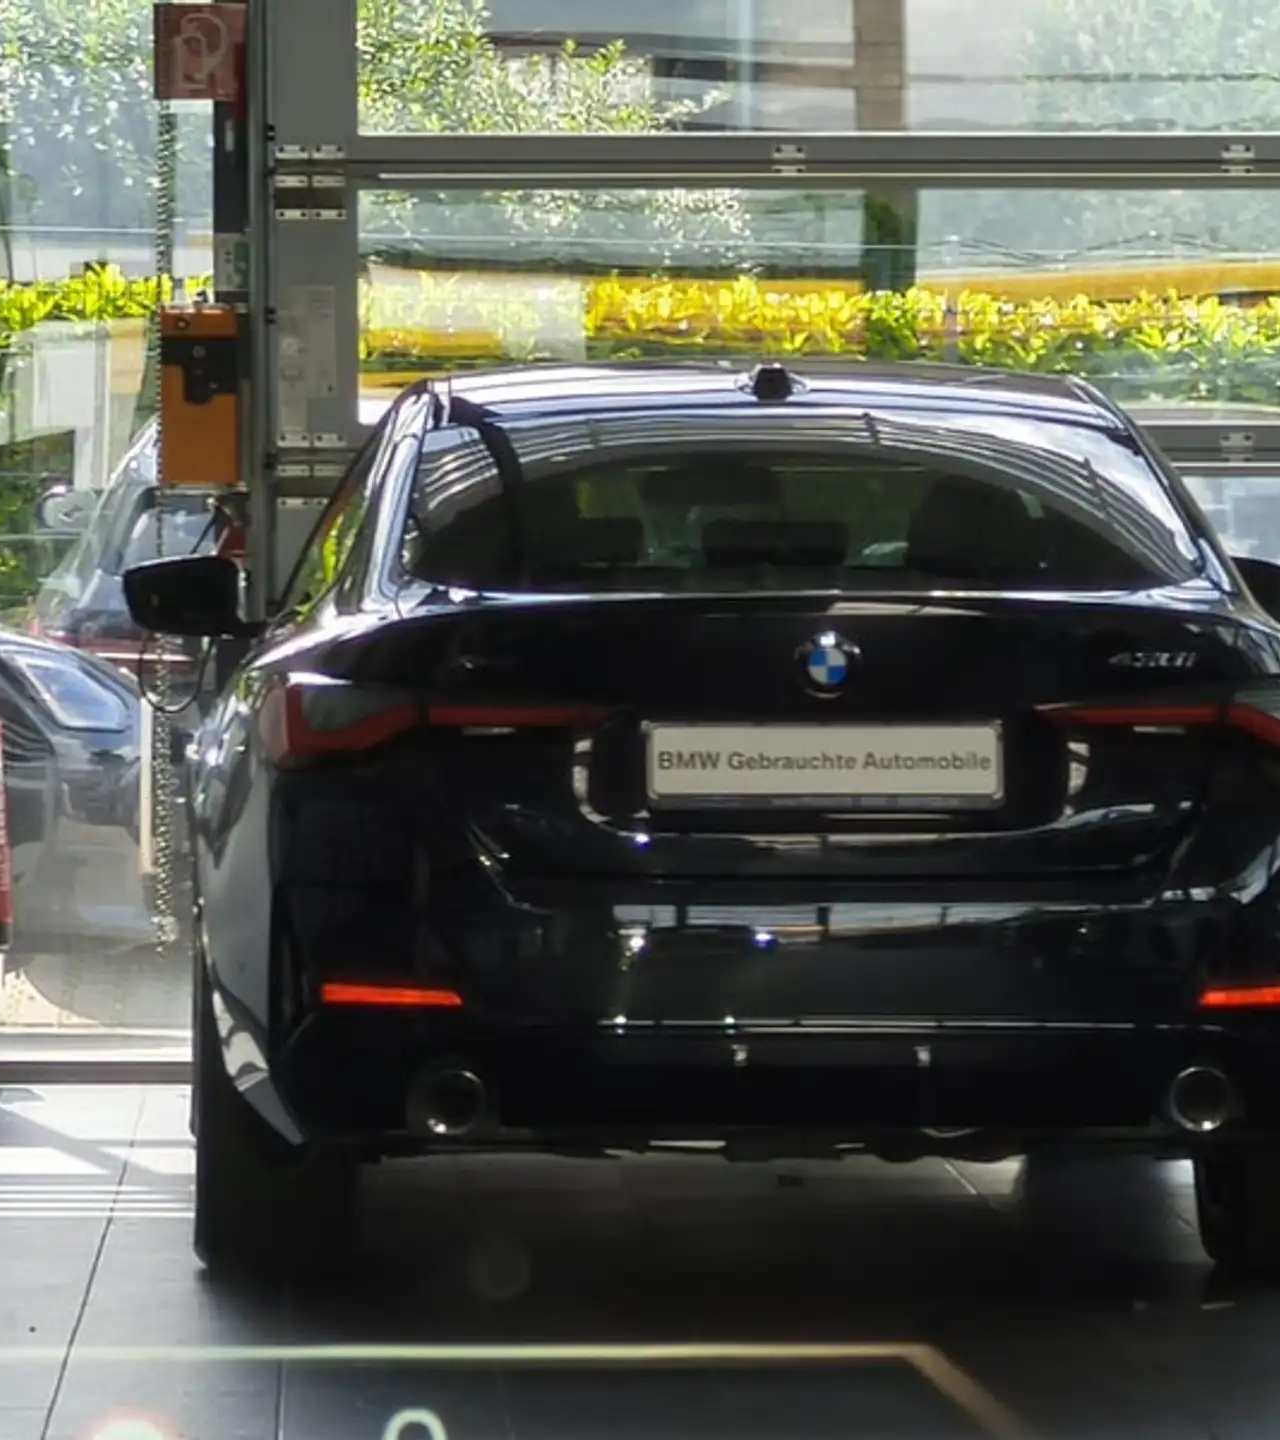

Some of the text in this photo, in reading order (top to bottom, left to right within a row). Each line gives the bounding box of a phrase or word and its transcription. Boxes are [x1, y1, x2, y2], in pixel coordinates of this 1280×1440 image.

[658, 750, 993, 771] BMW Gebrauchte Automobile
